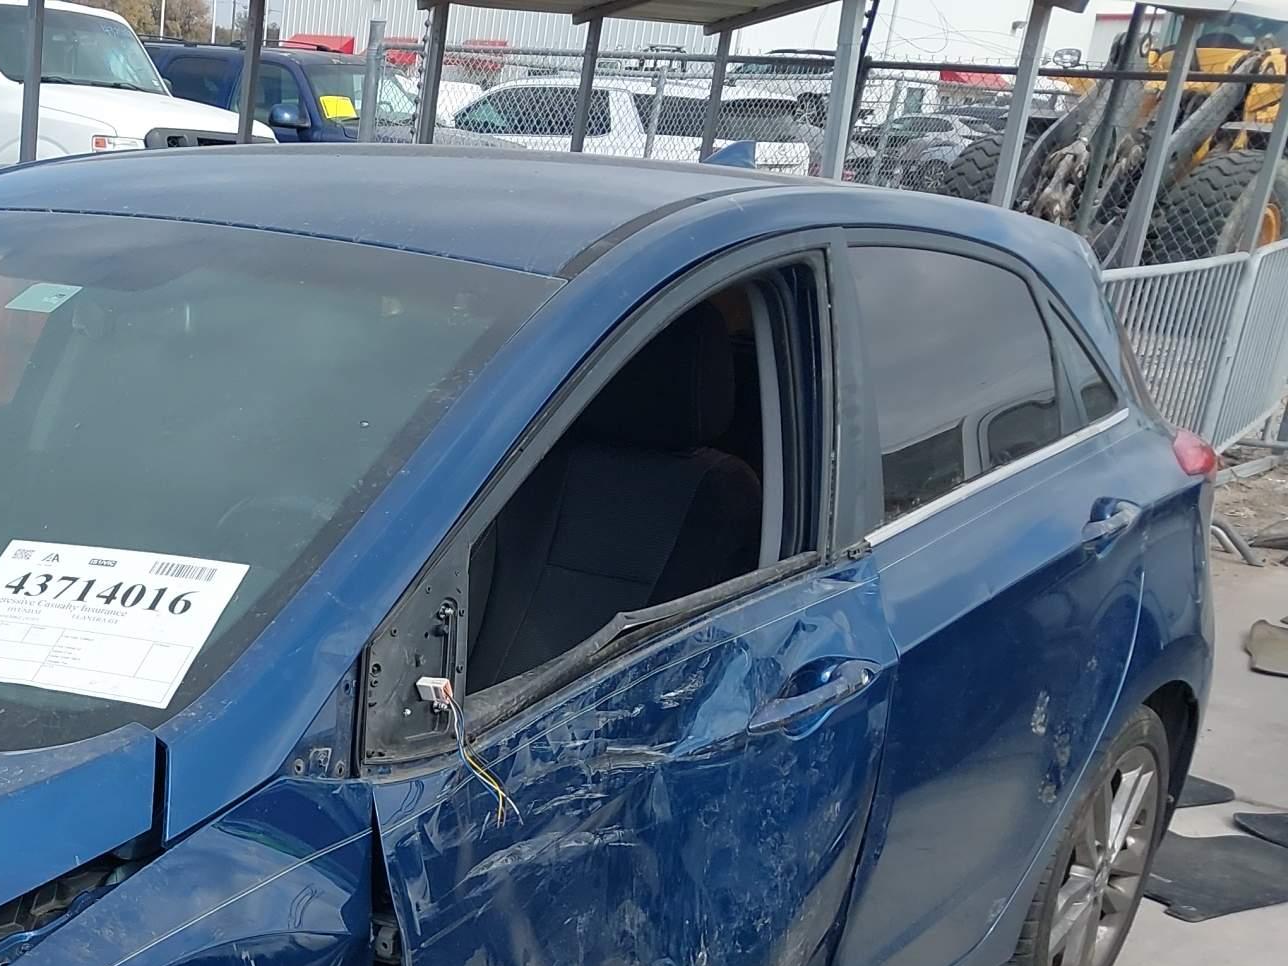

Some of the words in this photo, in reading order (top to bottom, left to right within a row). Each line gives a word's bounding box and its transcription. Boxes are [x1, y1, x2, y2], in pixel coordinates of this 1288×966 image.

[5, 571, 200, 615] 43714016
[37, 600, 80, 613] Casualty
[80, 605, 128, 617] Insurance
